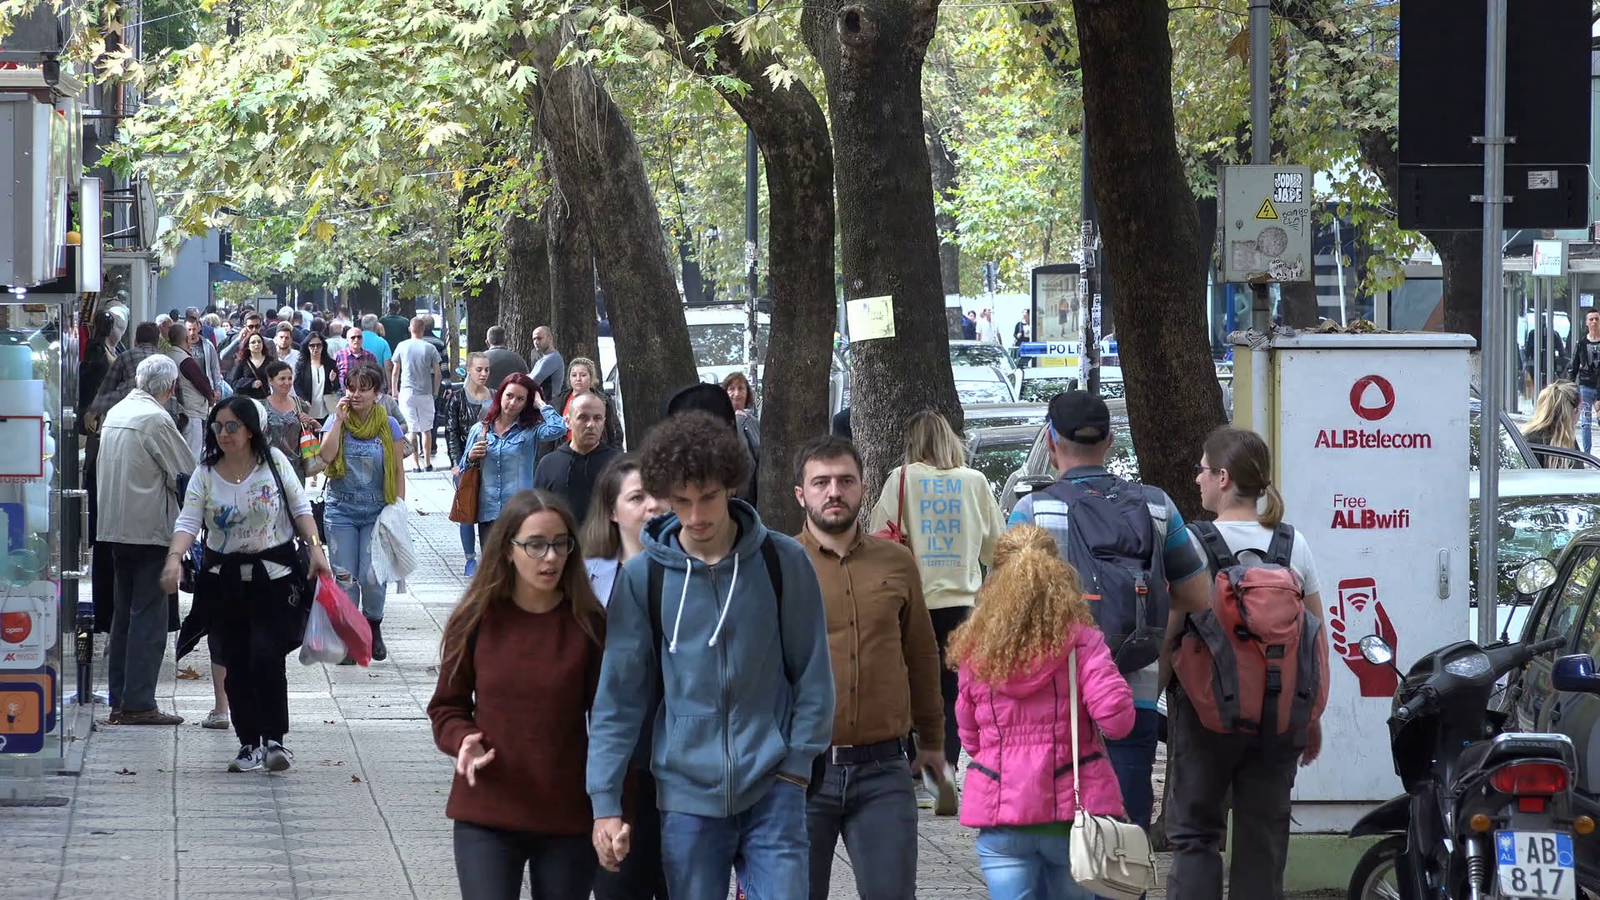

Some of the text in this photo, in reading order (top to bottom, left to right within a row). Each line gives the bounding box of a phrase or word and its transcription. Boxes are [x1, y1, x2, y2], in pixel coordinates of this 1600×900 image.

[1314, 429, 1432, 449] ALBtelecom
[919, 478, 962, 494] TEM
[920, 498, 962, 515] POR
[1333, 494, 1367, 508] Free
[921, 519, 961, 534] RAR
[1331, 509, 1410, 529] ALBwifi
[927, 536, 954, 551] ILY
[1500, 853, 1514, 861] AL
[1527, 837, 1557, 865] AB
[1511, 867, 1565, 896] 817
